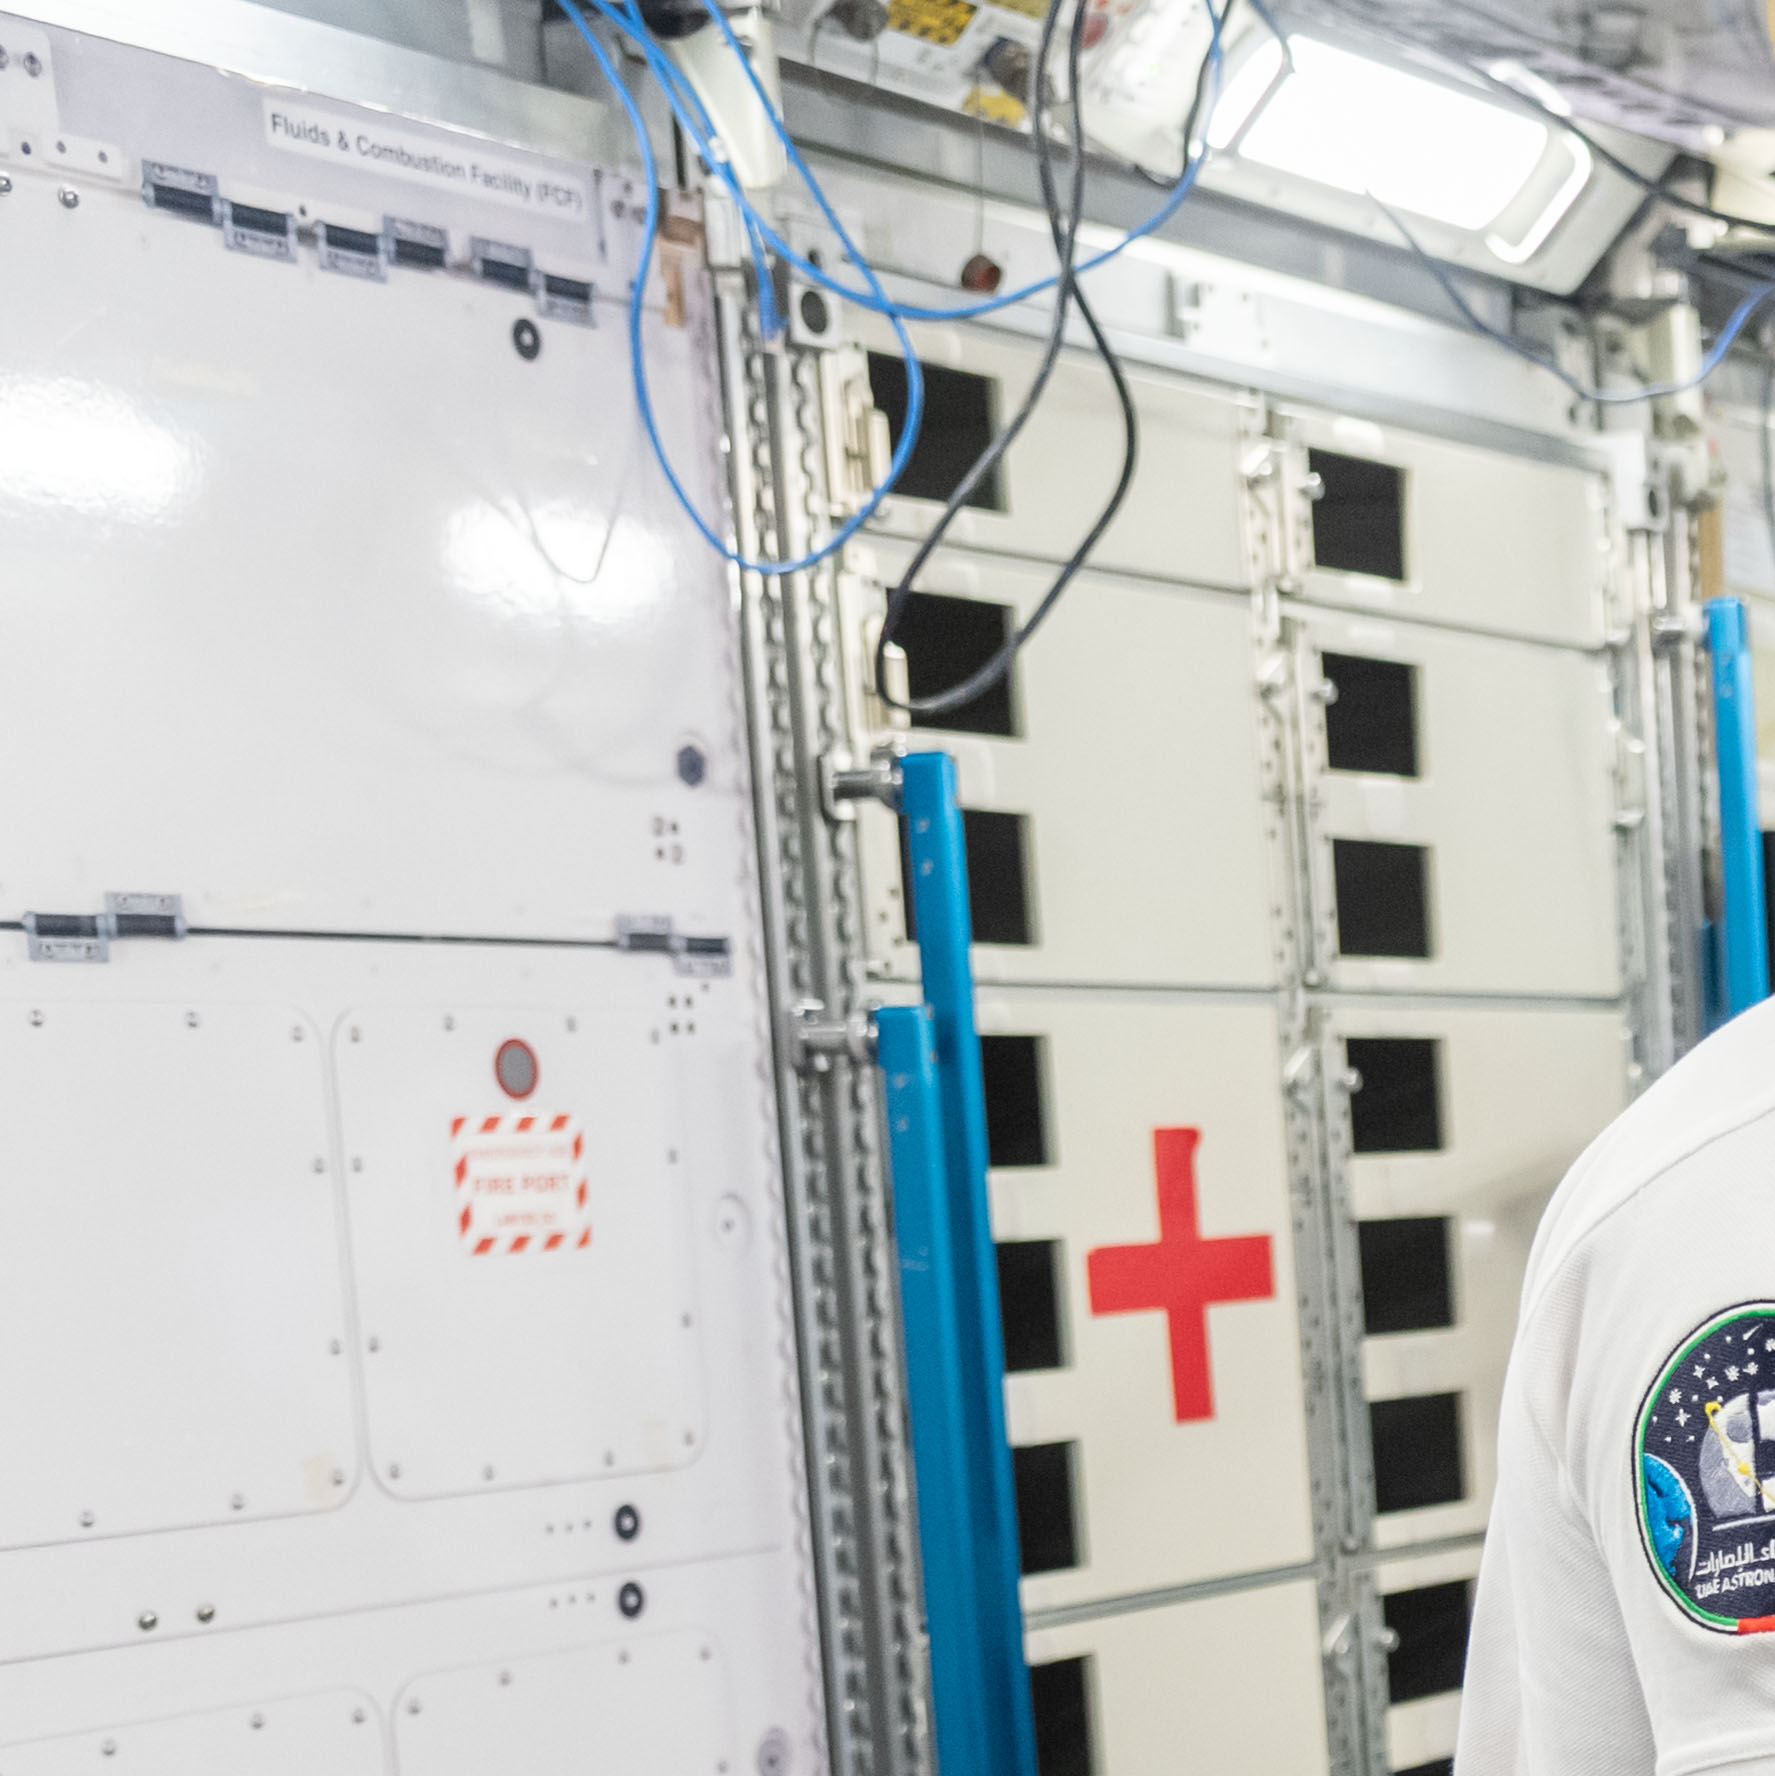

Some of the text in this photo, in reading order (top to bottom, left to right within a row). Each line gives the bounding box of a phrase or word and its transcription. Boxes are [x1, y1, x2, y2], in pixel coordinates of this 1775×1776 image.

[270, 112, 330, 149] Fluids
[337, 130, 350, 152] &
[355, 133, 466, 180] Combustion
[470, 164, 532, 199] Facility
[1694, 1578, 1721, 1600] UAE
